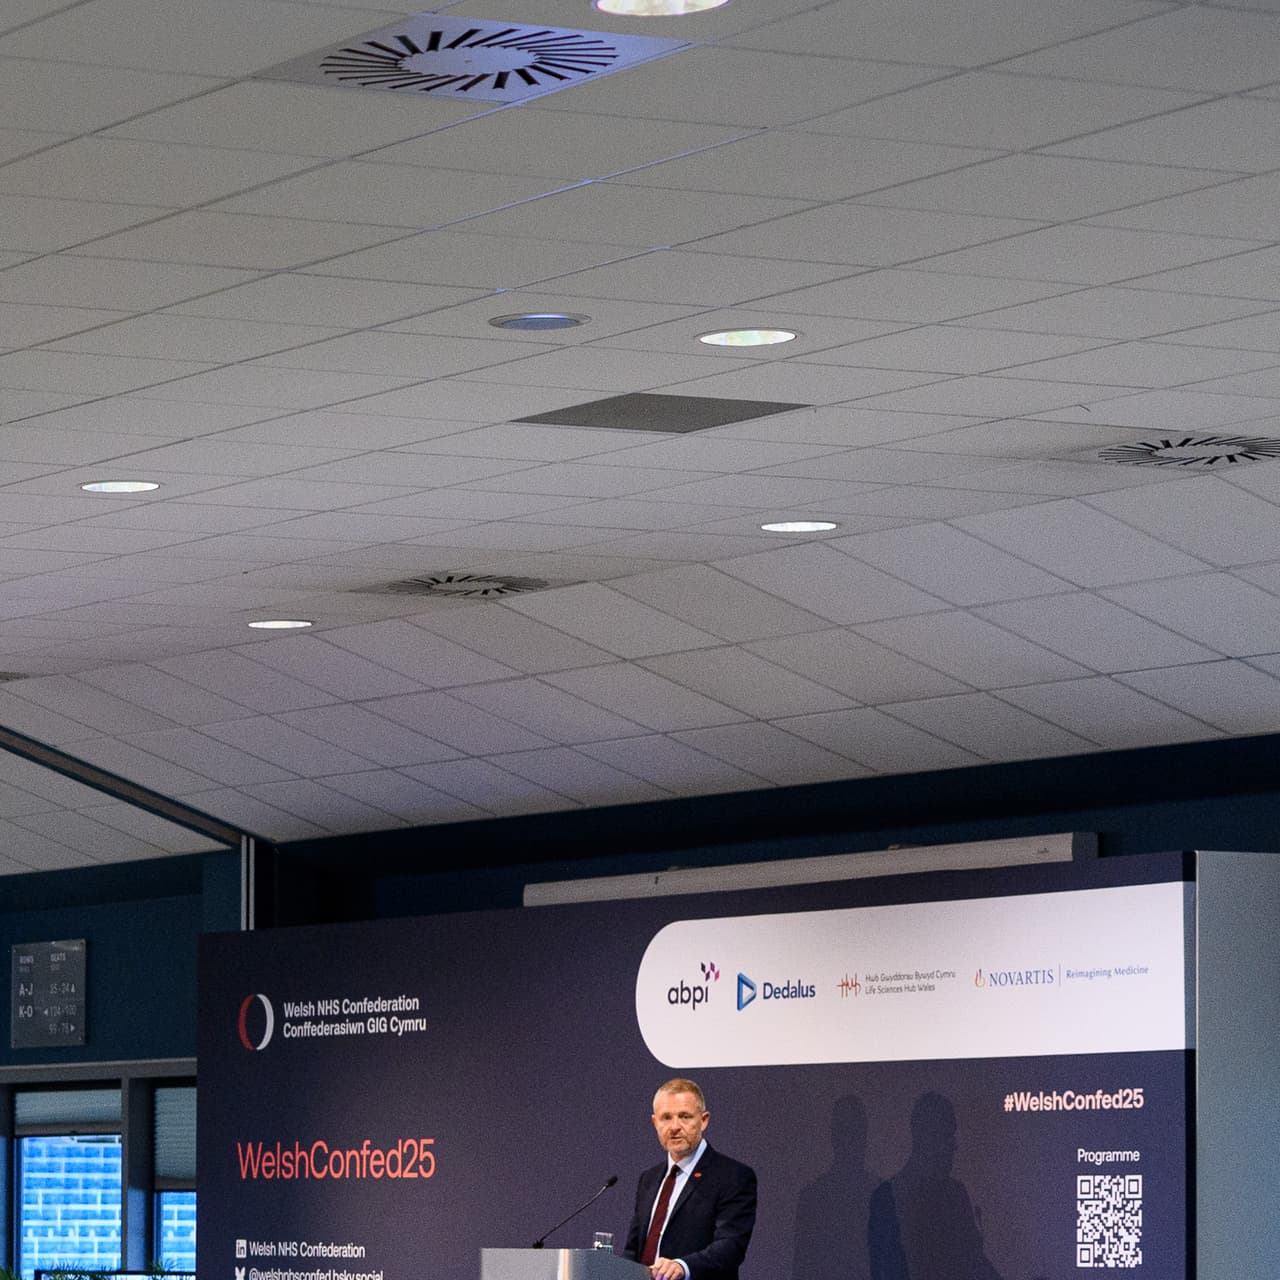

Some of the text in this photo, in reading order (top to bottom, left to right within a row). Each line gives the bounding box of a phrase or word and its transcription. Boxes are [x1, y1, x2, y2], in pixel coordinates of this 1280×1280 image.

[989, 969, 1054, 987] NOVARTIS
[1066, 964, 1149, 980] Reimagining Medicine
[667, 979, 709, 1011] abpi
[763, 979, 816, 1000] Dedalus
[865, 985, 876, 995] Life
[877, 984, 903, 995] Sciences
[283, 995, 420, 1018] Welsh NHS Confederation
[283, 1016, 427, 1038] Conffederasiwn GIG Cymru
[1004, 1088, 1144, 1112] #WelshConfed25
[237, 1138, 436, 1179] WelshConfed25
[1077, 1148, 1141, 1166] Programme
[249, 1241, 277, 1257] Welsh
[278, 1241, 298, 1257] NHS
[300, 1242, 366, 1258] Confederation
